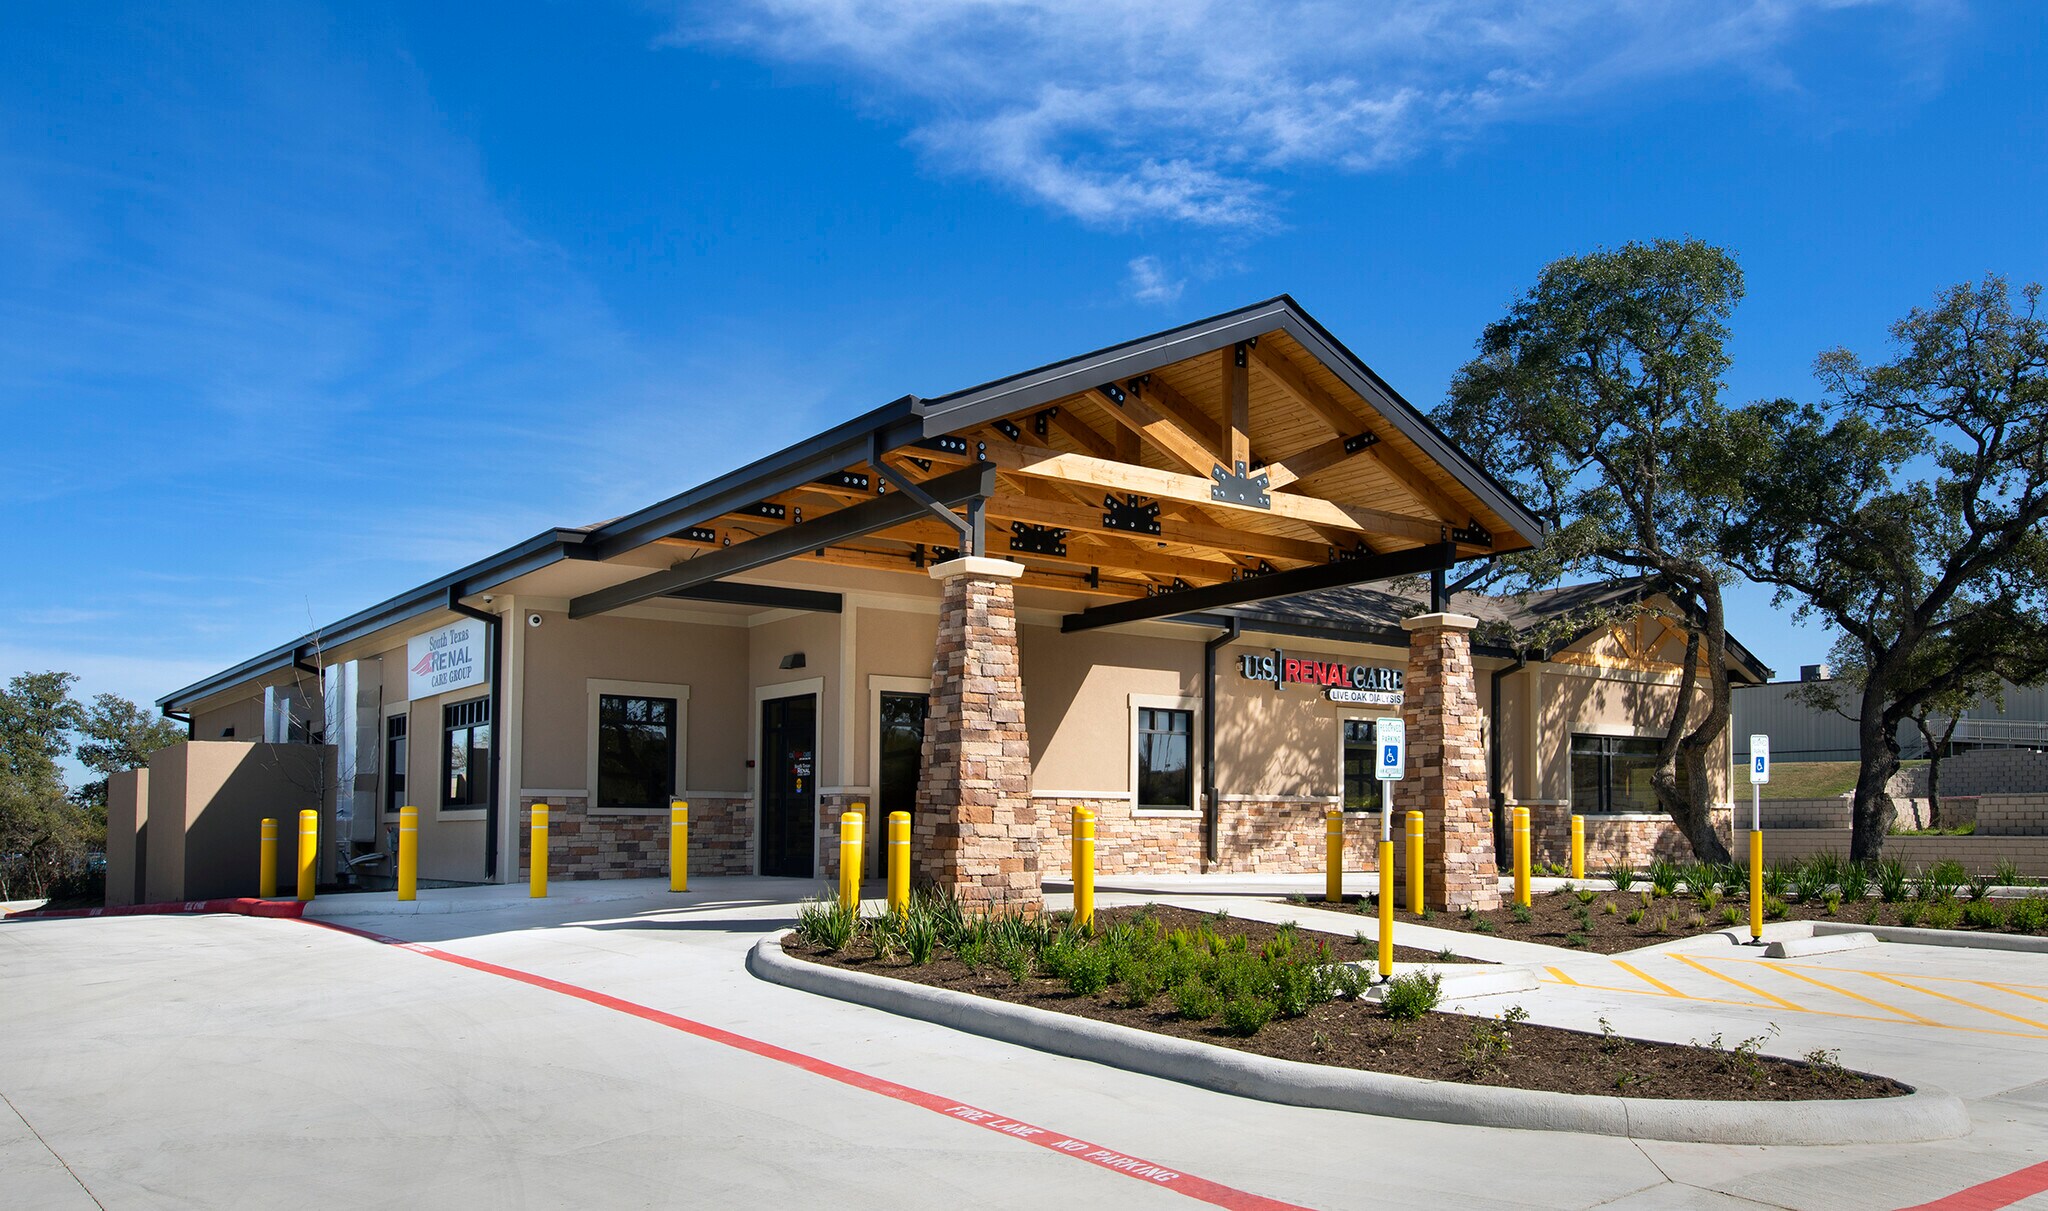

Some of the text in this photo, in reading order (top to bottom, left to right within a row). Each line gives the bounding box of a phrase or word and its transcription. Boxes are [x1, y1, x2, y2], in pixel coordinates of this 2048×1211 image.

[429, 629, 470, 652] South Texas
[431, 646, 473, 673] RENAL
[431, 665, 473, 688] CARE GROUP
[1242, 654, 1404, 691] U.S. RENAL CARE
[1332, 690, 1402, 704] LIVE OAK DIALYSIS
[944, 1106, 1180, 1182] FIRE LANE NO PARKING
